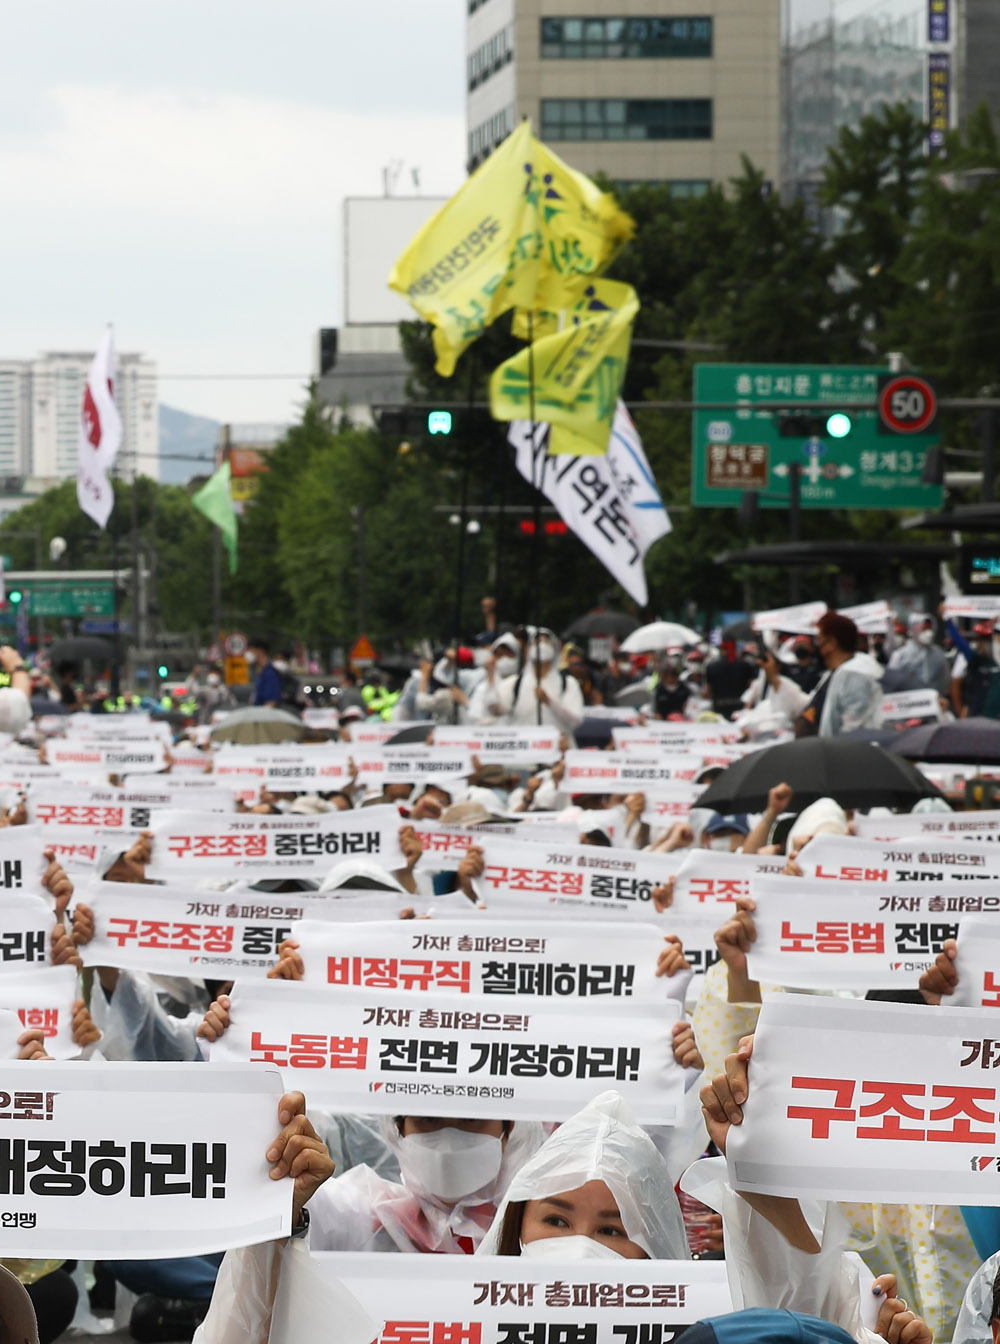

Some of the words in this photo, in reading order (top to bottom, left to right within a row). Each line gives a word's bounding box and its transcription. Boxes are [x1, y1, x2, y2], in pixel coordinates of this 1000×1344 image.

[891, 391, 925, 419] 50
[35, 804, 124, 828] 구조조정
[168, 835, 268, 858] 구조조정
[274, 831, 381, 857] 중단하라!
[414, 831, 472, 851] 정규직
[883, 852, 913, 863] 가자!
[917, 853, 986, 867] 총파업으로!
[484, 865, 584, 896] 구조조정
[186, 902, 220, 917] 가자!
[226, 904, 303, 920] 총파업으로!
[879, 896, 922, 911] 가자!
[106, 917, 235, 953] 구조조정
[411, 934, 452, 951] 가자!
[456, 935, 547, 954] 총파업으로!
[780, 920, 886, 954] 노동법
[327, 956, 472, 993] 비정규직
[481, 961, 636, 997] 철폐하라!
[362, 1006, 413, 1028] 가자!
[418, 1009, 531, 1032] 총파업으로!
[250, 1031, 369, 1071] 노동법
[378, 1037, 460, 1074] 전면
[468, 1042, 641, 1081] 개정하라!
[384, 1081, 515, 1099] 전국민주노동조합총연맹
[787, 1075, 1000, 1145] 구조조
[473, 1280, 538, 1307] 가자!
[544, 1281, 690, 1308] 총파업으로!
